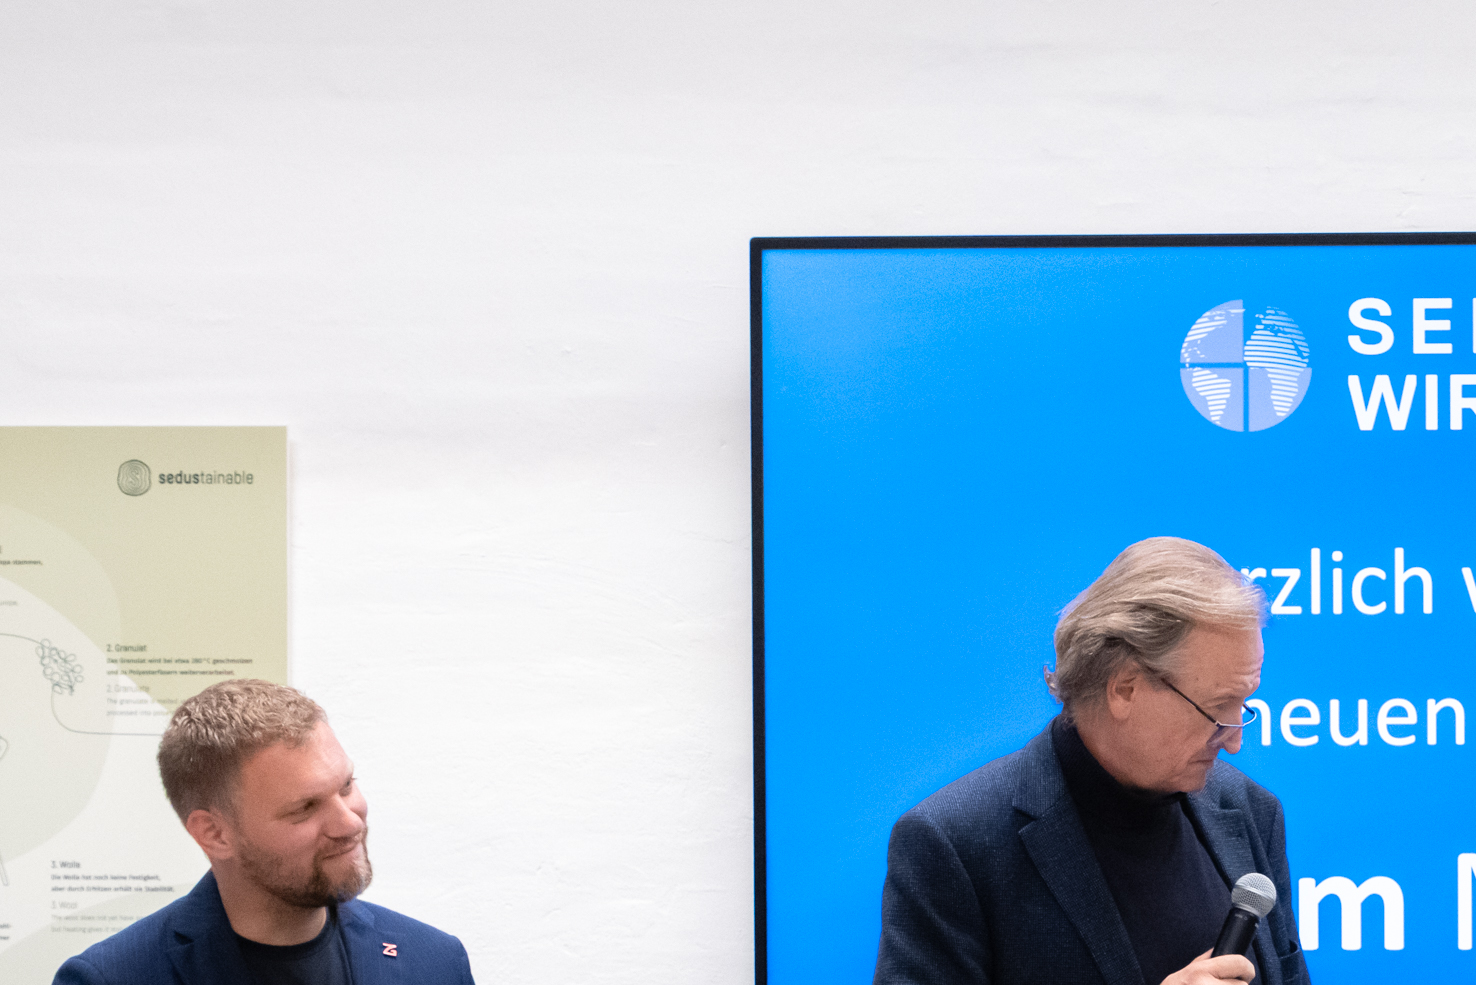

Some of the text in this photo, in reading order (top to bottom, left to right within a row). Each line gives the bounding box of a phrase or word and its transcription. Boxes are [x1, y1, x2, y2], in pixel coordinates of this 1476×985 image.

[159, 470, 254, 485] sedustainable
[115, 644, 147, 652] Granulat
[60, 861, 80, 869] Wolle
